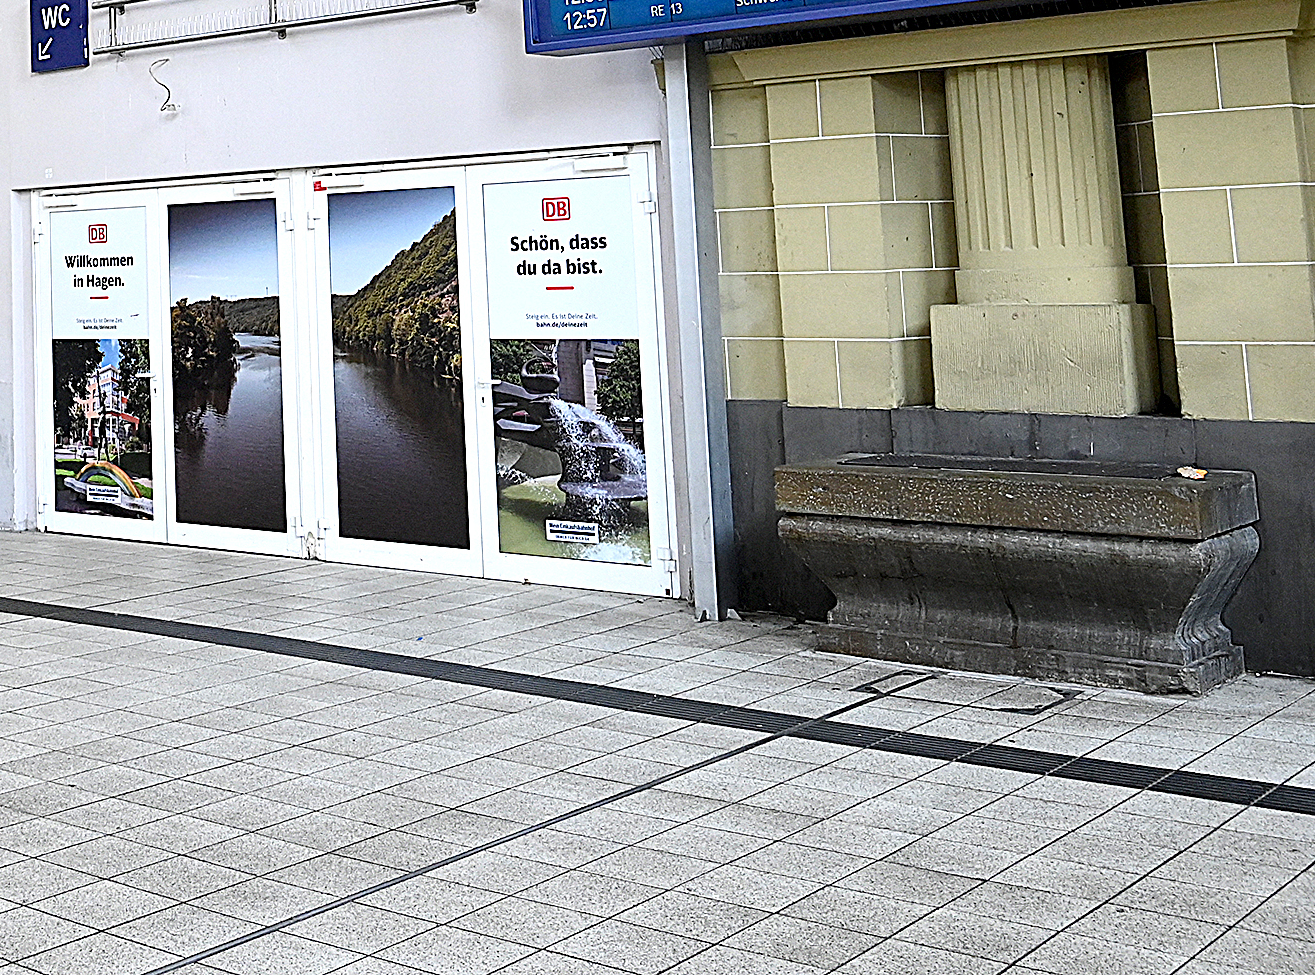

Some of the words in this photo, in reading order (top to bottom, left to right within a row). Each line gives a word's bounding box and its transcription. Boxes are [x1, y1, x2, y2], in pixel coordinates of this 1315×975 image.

[41, 3, 70, 29] WC
[564, 8, 606, 30] 12:57
[651, 5, 665, 16] RE
[671, 3, 682, 14] 13
[545, 200, 568, 218] DB
[90, 227, 106, 241] DB
[510, 235, 565, 253] Schön,
[569, 234, 607, 249] dass
[65, 255, 134, 268] Willkommen
[516, 260, 537, 275] du
[542, 259, 561, 275] da
[566, 258, 603, 274] bist.
[73, 274, 83, 287] in
[86, 275, 124, 290] Hagen.
